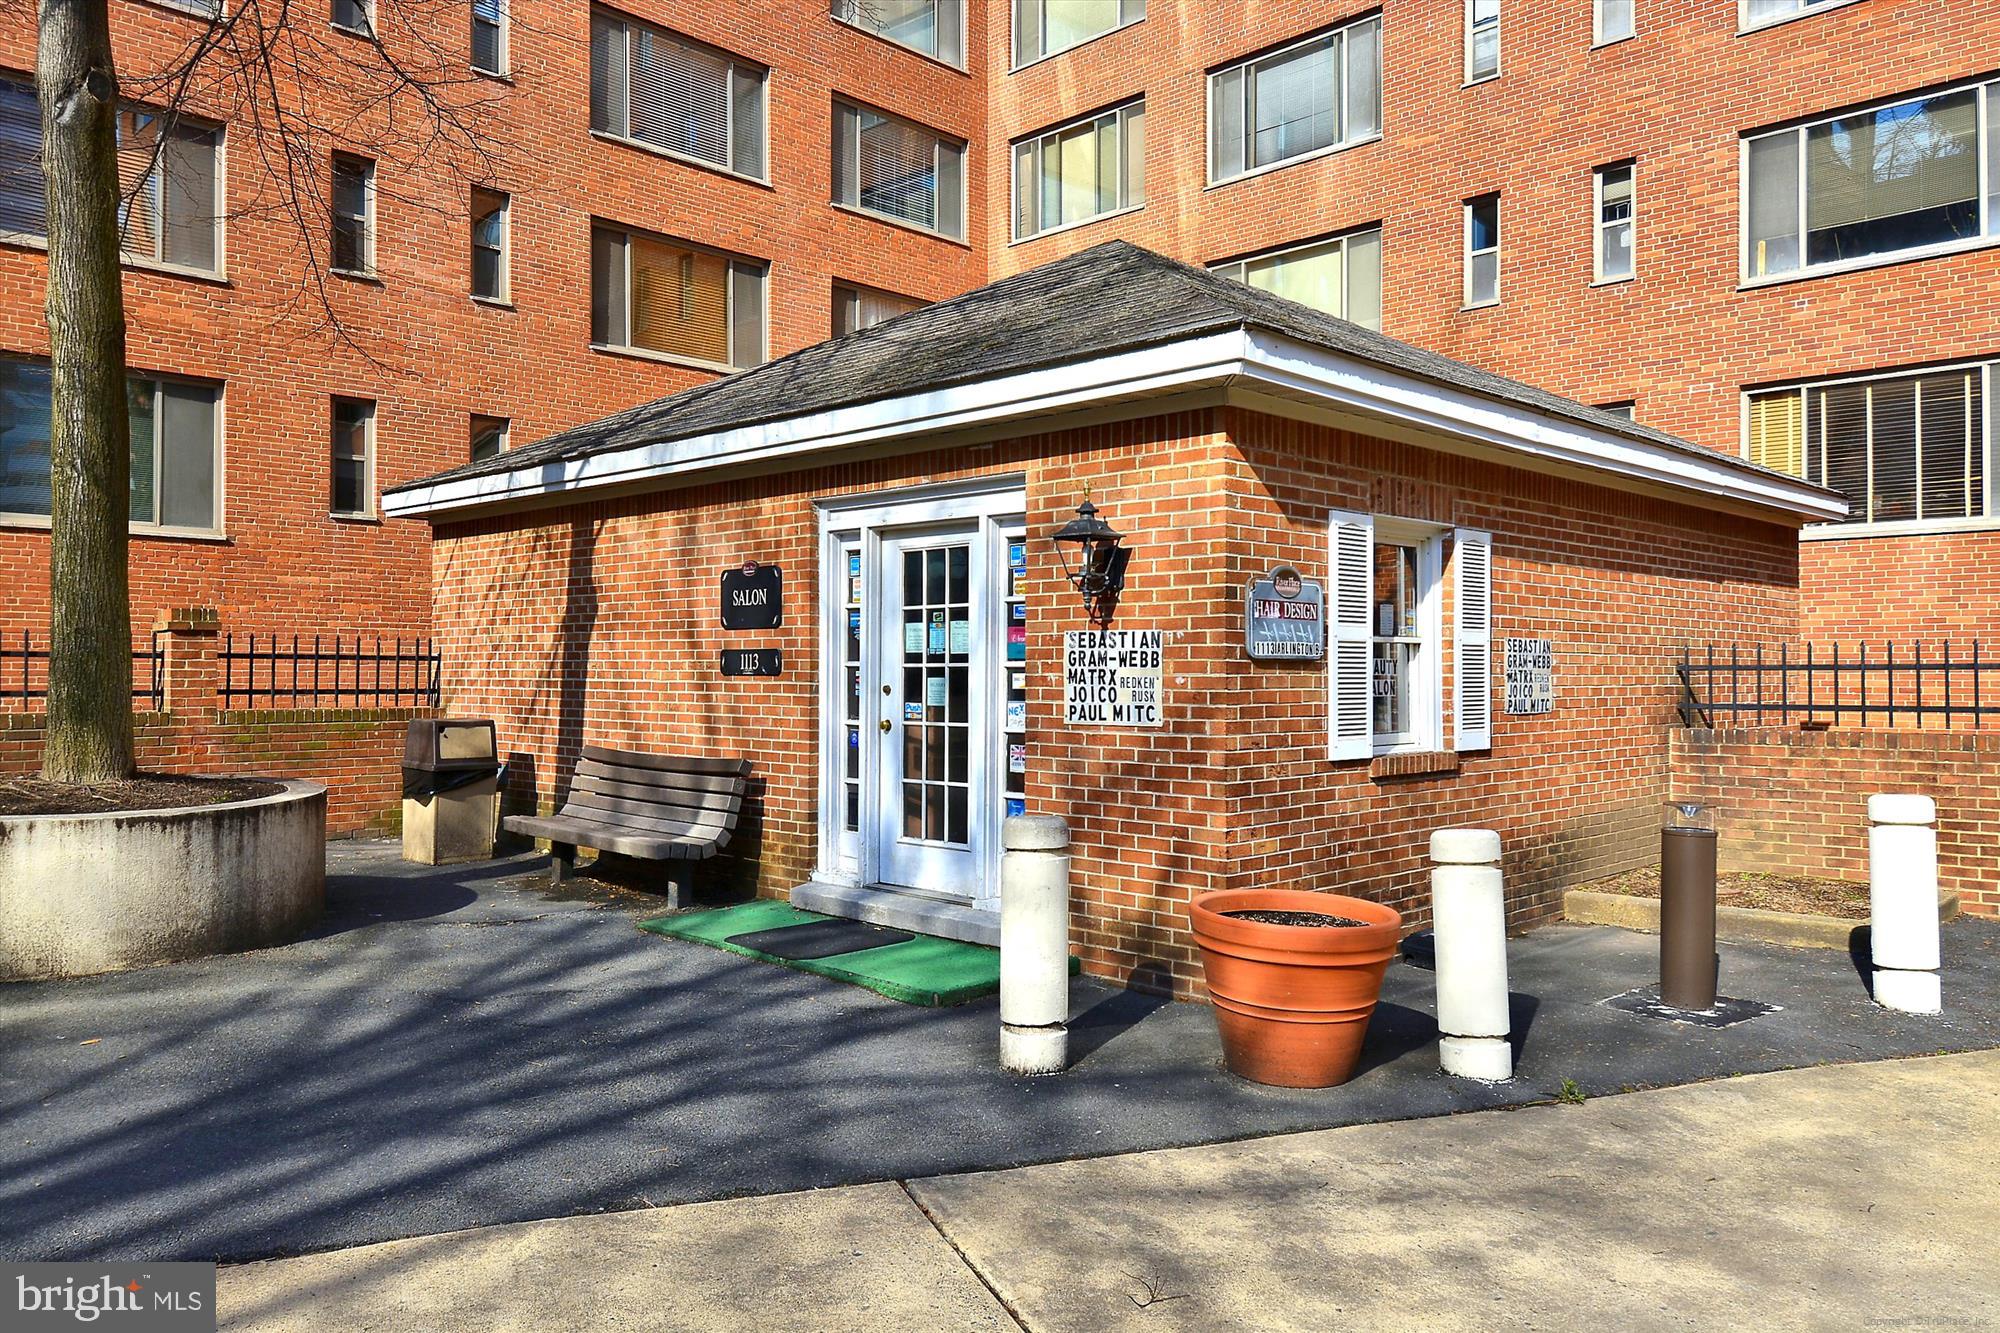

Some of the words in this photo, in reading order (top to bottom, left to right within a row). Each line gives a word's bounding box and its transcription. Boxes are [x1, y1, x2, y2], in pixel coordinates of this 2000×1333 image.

[732, 588, 767, 607] SALON
[1255, 600, 1281, 618] HAIR
[1284, 602, 1317, 620] DESIGN
[1068, 631, 1161, 649] SEBASTIAN
[1507, 638, 1551, 654] SEBASTIAN
[1256, 642, 1275, 655] 1113
[740, 653, 759, 670] 1113
[1068, 650, 1160, 668] GRAM-WEBB
[1507, 655, 1551, 669] GRAM-WEBB
[1068, 669, 1117, 686] MATRX
[1119, 676, 1155, 689] REDKEN
[1506, 669, 1534, 684] MATRX
[1069, 686, 1117, 703] JOICO
[1131, 690, 1155, 703] RUSK
[1507, 684, 1533, 698] JOICO
[905, 703, 922, 712] Push
[1068, 705, 1107, 721] PAUL
[1506, 699, 1528, 713] PAUL
